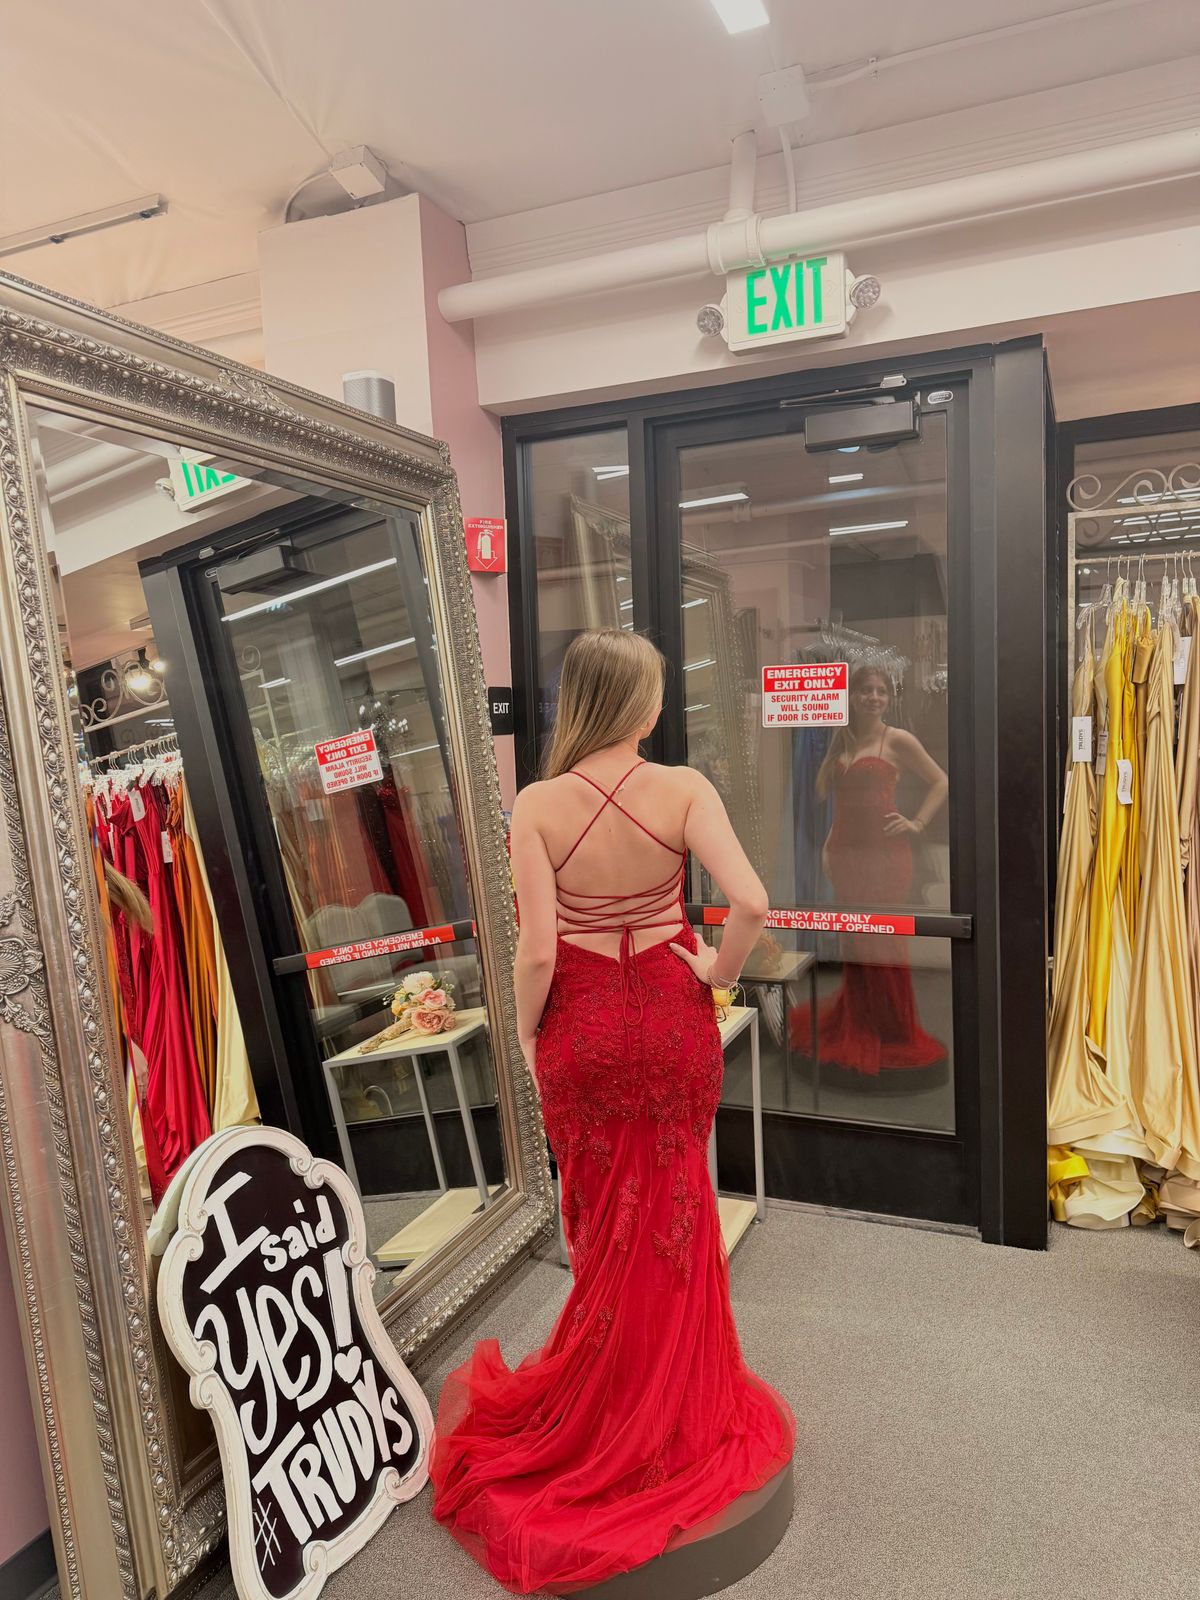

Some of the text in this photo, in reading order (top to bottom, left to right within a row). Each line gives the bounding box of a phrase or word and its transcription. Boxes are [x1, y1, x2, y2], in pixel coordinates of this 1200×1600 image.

[746, 256, 828, 336] EXIT
[767, 666, 843, 679] EMERGENCY
[774, 679, 835, 690] EXIT ONLY
[771, 693, 840, 703] SECURITY ALARM
[493, 702, 510, 714] EXIT
[780, 703, 829, 712] WILL SOUND
[767, 712, 843, 722] IF DOOR IS OPENED
[767, 910, 871, 923] RGENCY EXIT ONLY
[790, 920, 830, 930] SOUND
[833, 923, 843, 931] IF
[846, 923, 895, 934] OPENED
[200, 1171, 336, 1294] I said
